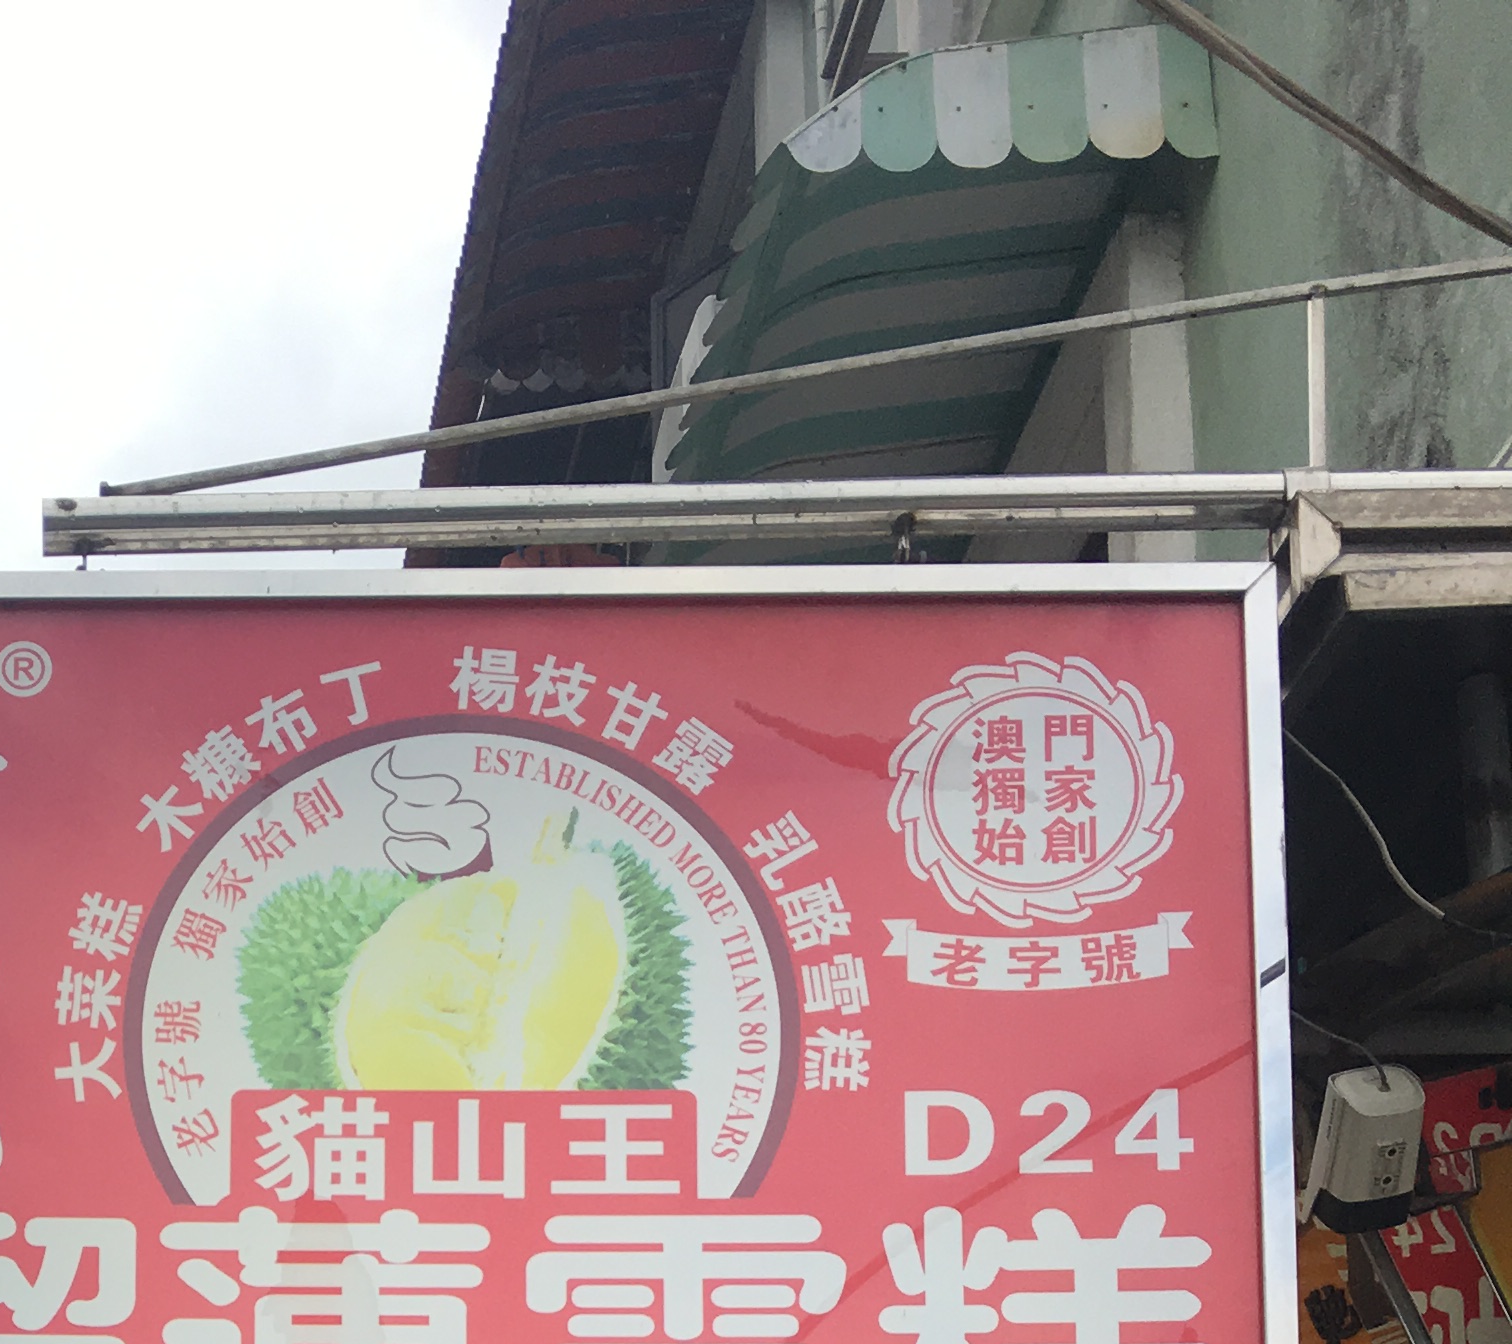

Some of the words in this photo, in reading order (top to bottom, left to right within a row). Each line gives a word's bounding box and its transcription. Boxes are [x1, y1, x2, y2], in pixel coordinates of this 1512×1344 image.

[449, 646, 735, 799] 楊枝甘露
[474, 744, 679, 851] ESTABLISHED
[171, 776, 345, 962] 獨家始創
[672, 841, 735, 932] MORE
[54, 891, 145, 1103] 大菜糕
[720, 923, 768, 1015] THAN
[743, 810, 872, 1093] 乳酪雪糕
[931, 932, 1143, 988] 老字號
[152, 999, 219, 1159] 老字號
[740, 1023, 768, 1055] 80
[254, 1096, 681, 1200] 貓山王
[711, 1064, 766, 1165] YEARS
